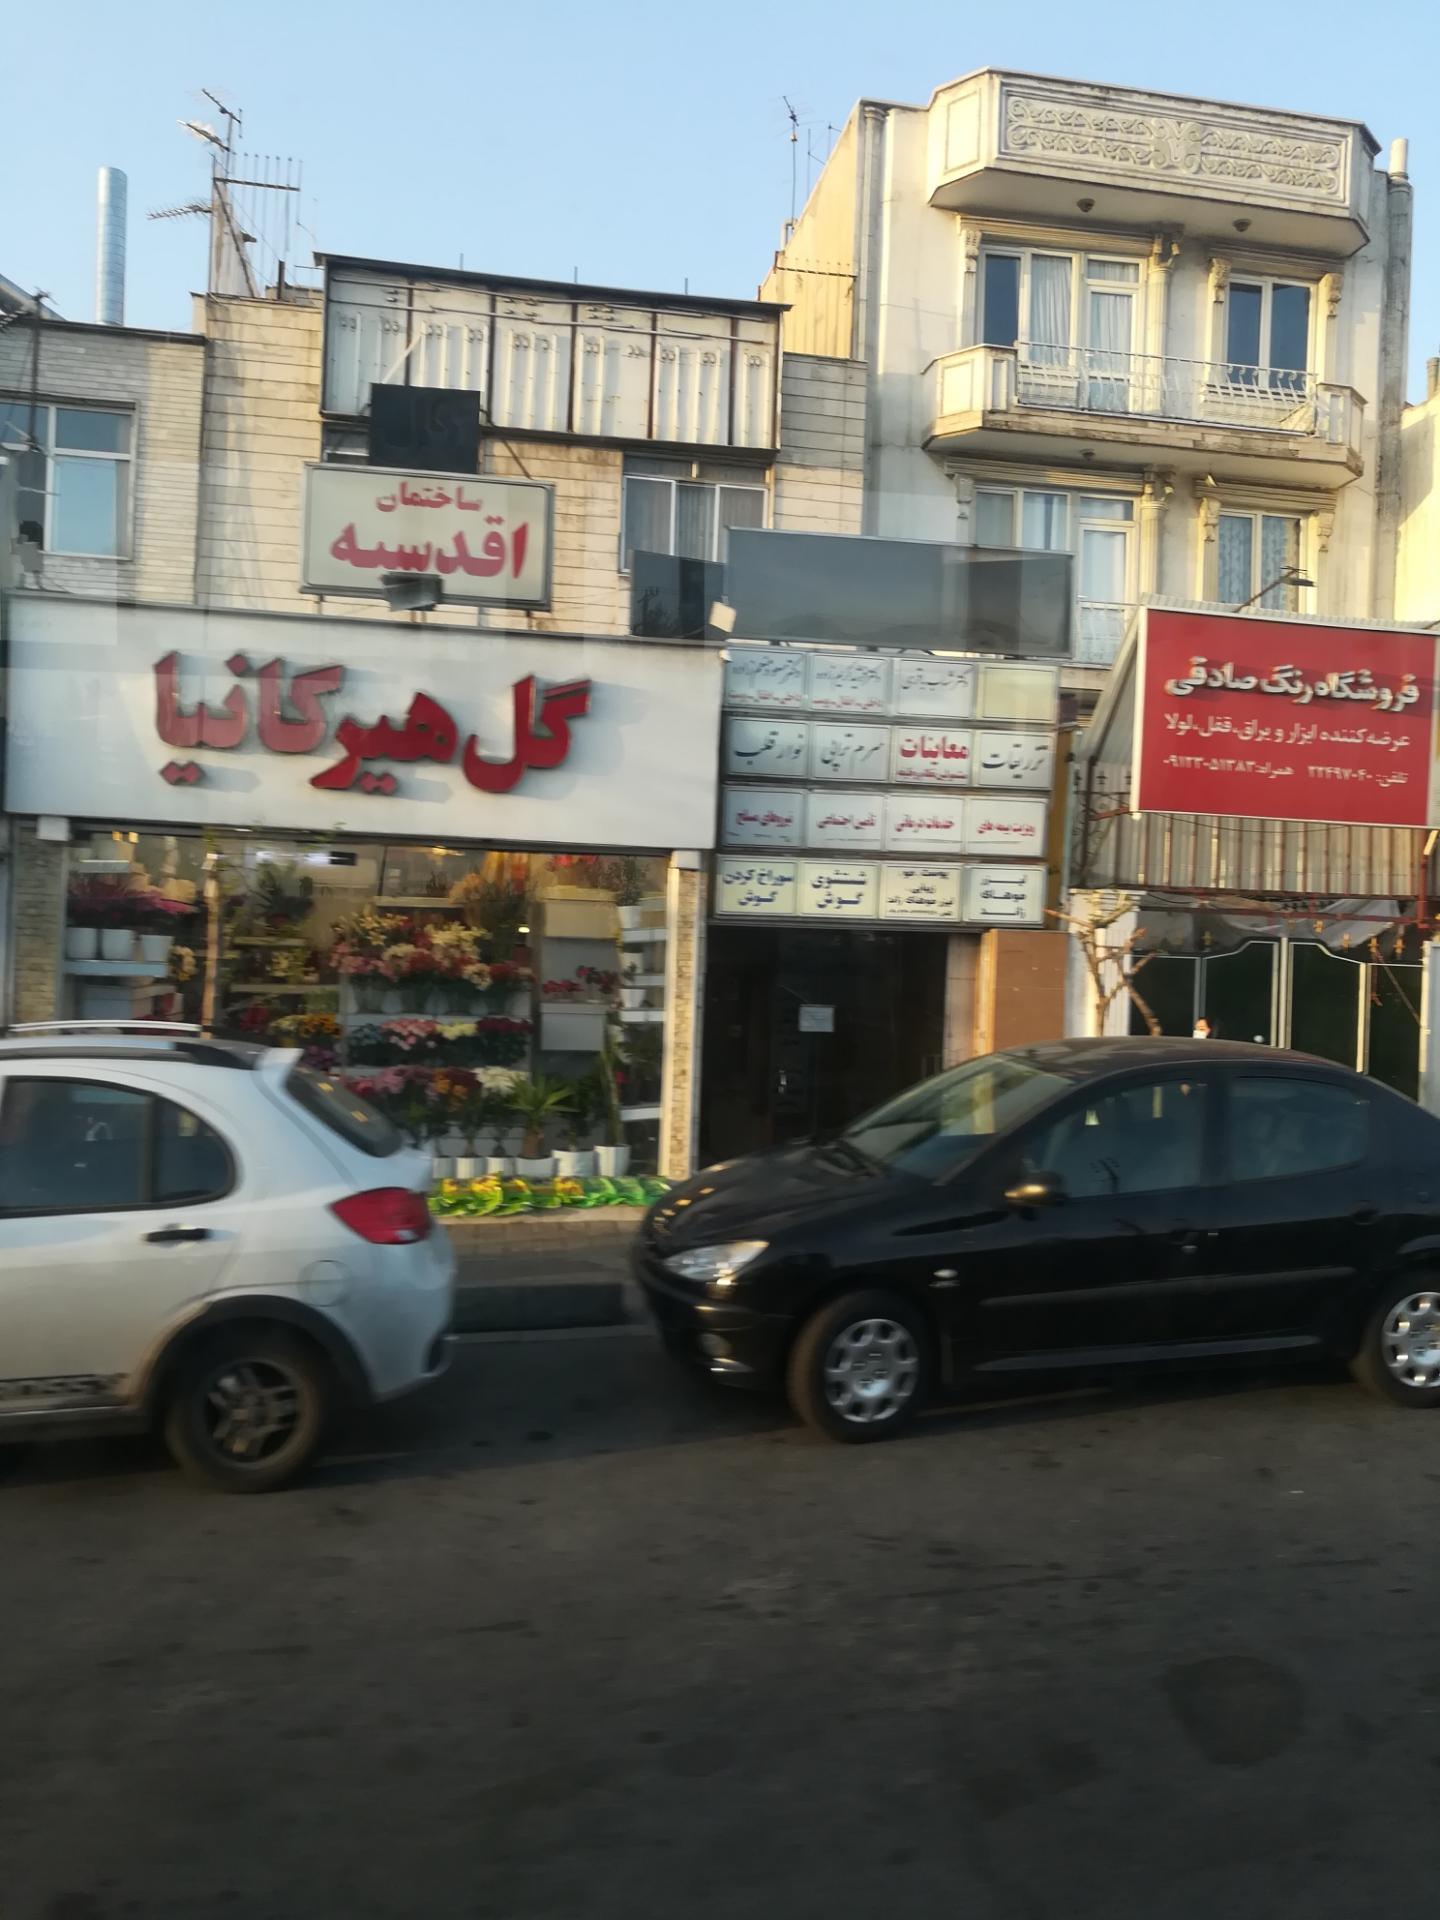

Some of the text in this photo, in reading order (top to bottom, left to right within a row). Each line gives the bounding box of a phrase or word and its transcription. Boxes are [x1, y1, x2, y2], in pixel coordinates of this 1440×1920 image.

[376, 481, 482, 512] ساختمان
[1165, 656, 1420, 712] فروشگاه رنگ صادقی
[462, 674, 591, 793] گل
[1273, 727, 1284, 743] و
[1286, 723, 1317, 745] ابزار
[1319, 728, 1368, 743] کننده
[1366, 731, 1410, 751] عرضه
[900, 736, 969, 765] معاینات
[722, 868, 794, 886] سوراخ کردن
[738, 889, 779, 907] گوش
[817, 891, 864, 909] گوش
